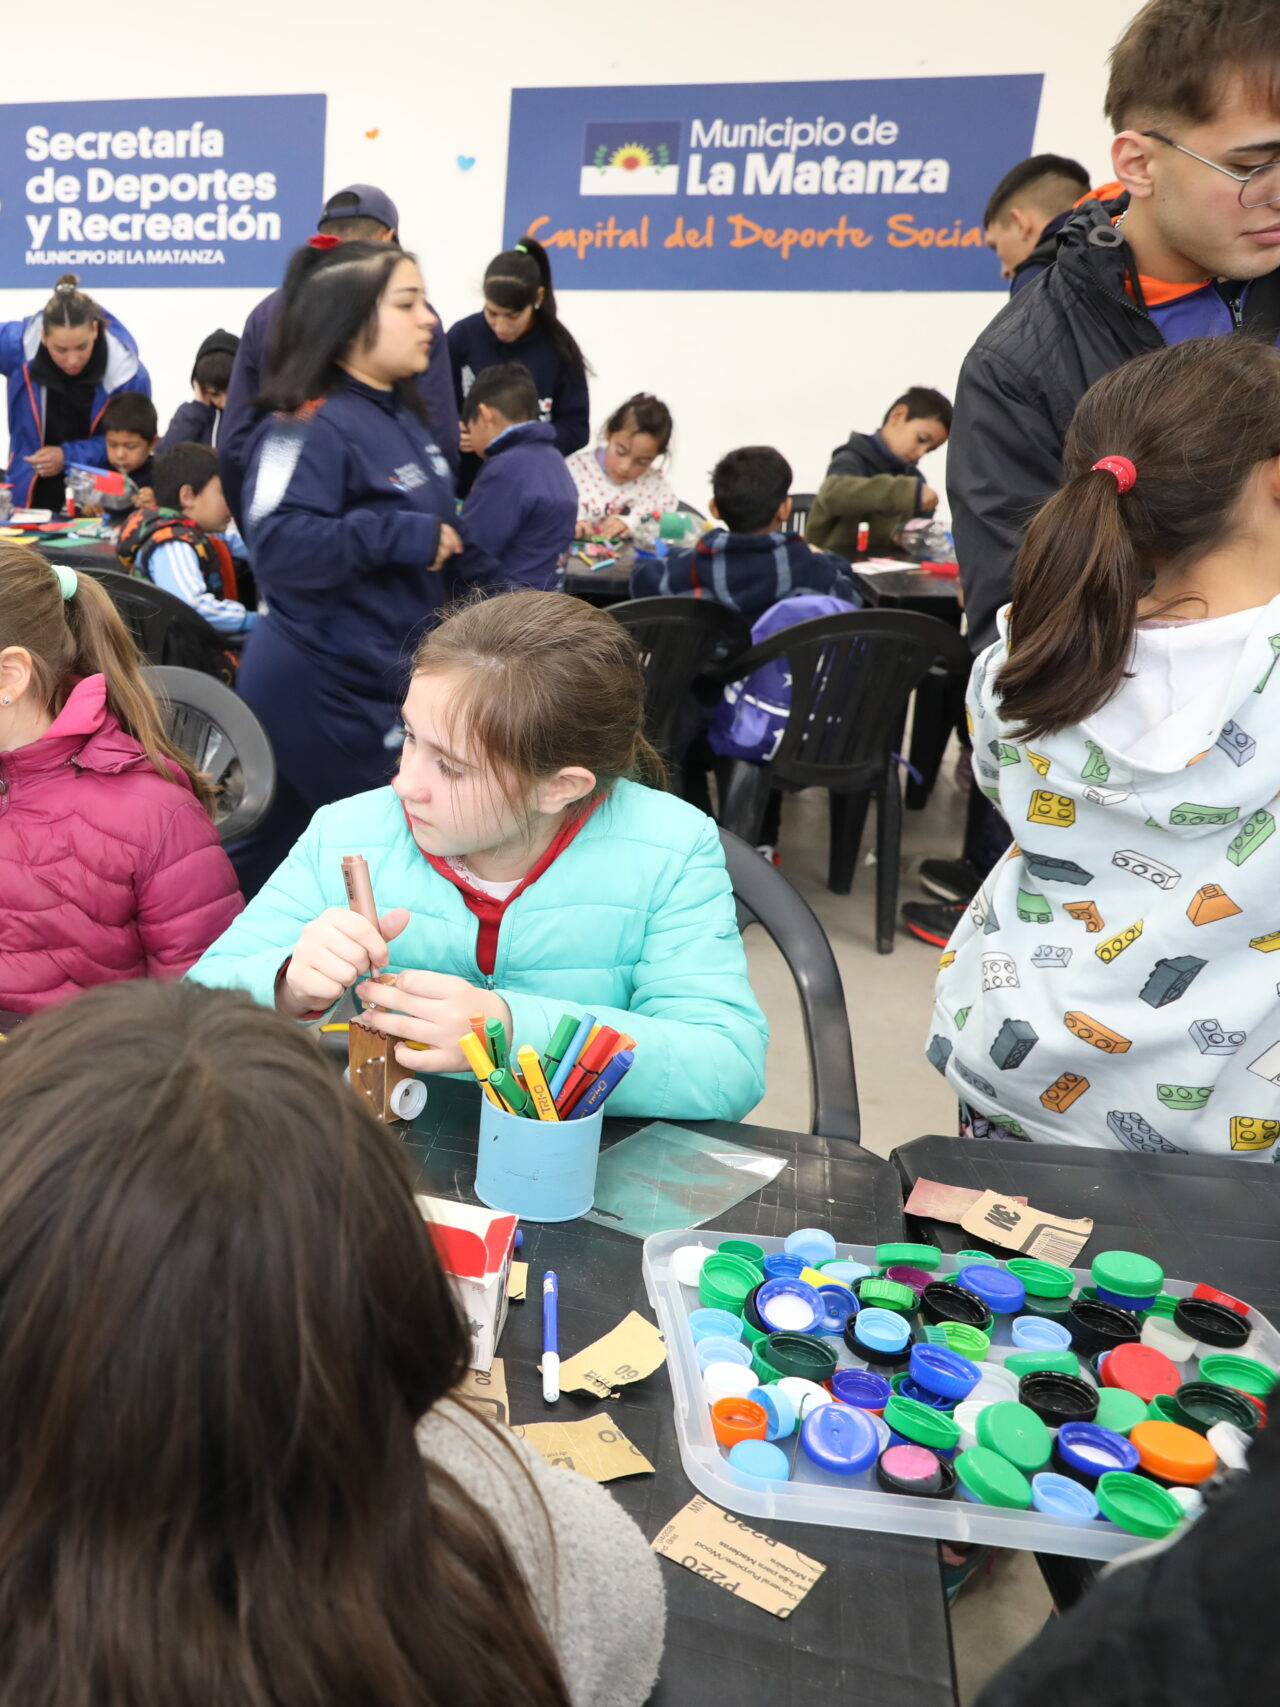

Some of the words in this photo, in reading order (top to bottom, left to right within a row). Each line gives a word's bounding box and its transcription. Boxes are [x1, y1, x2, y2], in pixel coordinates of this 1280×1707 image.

[25, 121, 224, 162] Secretaría
[690, 116, 846, 152] Municipio
[851, 114, 898, 146] de
[26, 167, 80, 203] de
[87, 167, 277, 210] Deportes
[686, 155, 736, 195] La
[743, 153, 950, 195] Matanza
[26, 213, 52, 249] y
[58, 204, 280, 242] Recreación
[526, 215, 650, 259] Capital
[665, 215, 714, 248] del
[726, 213, 873, 259] Deporte
[887, 213, 987, 248] Socia
[26, 251, 106, 265] MUNICIPIO
[107, 251, 126, 264] DE
[126, 250, 145, 264] LA
[146, 249, 225, 264] MATANZA
[984, 1204, 1021, 1232] 3M
